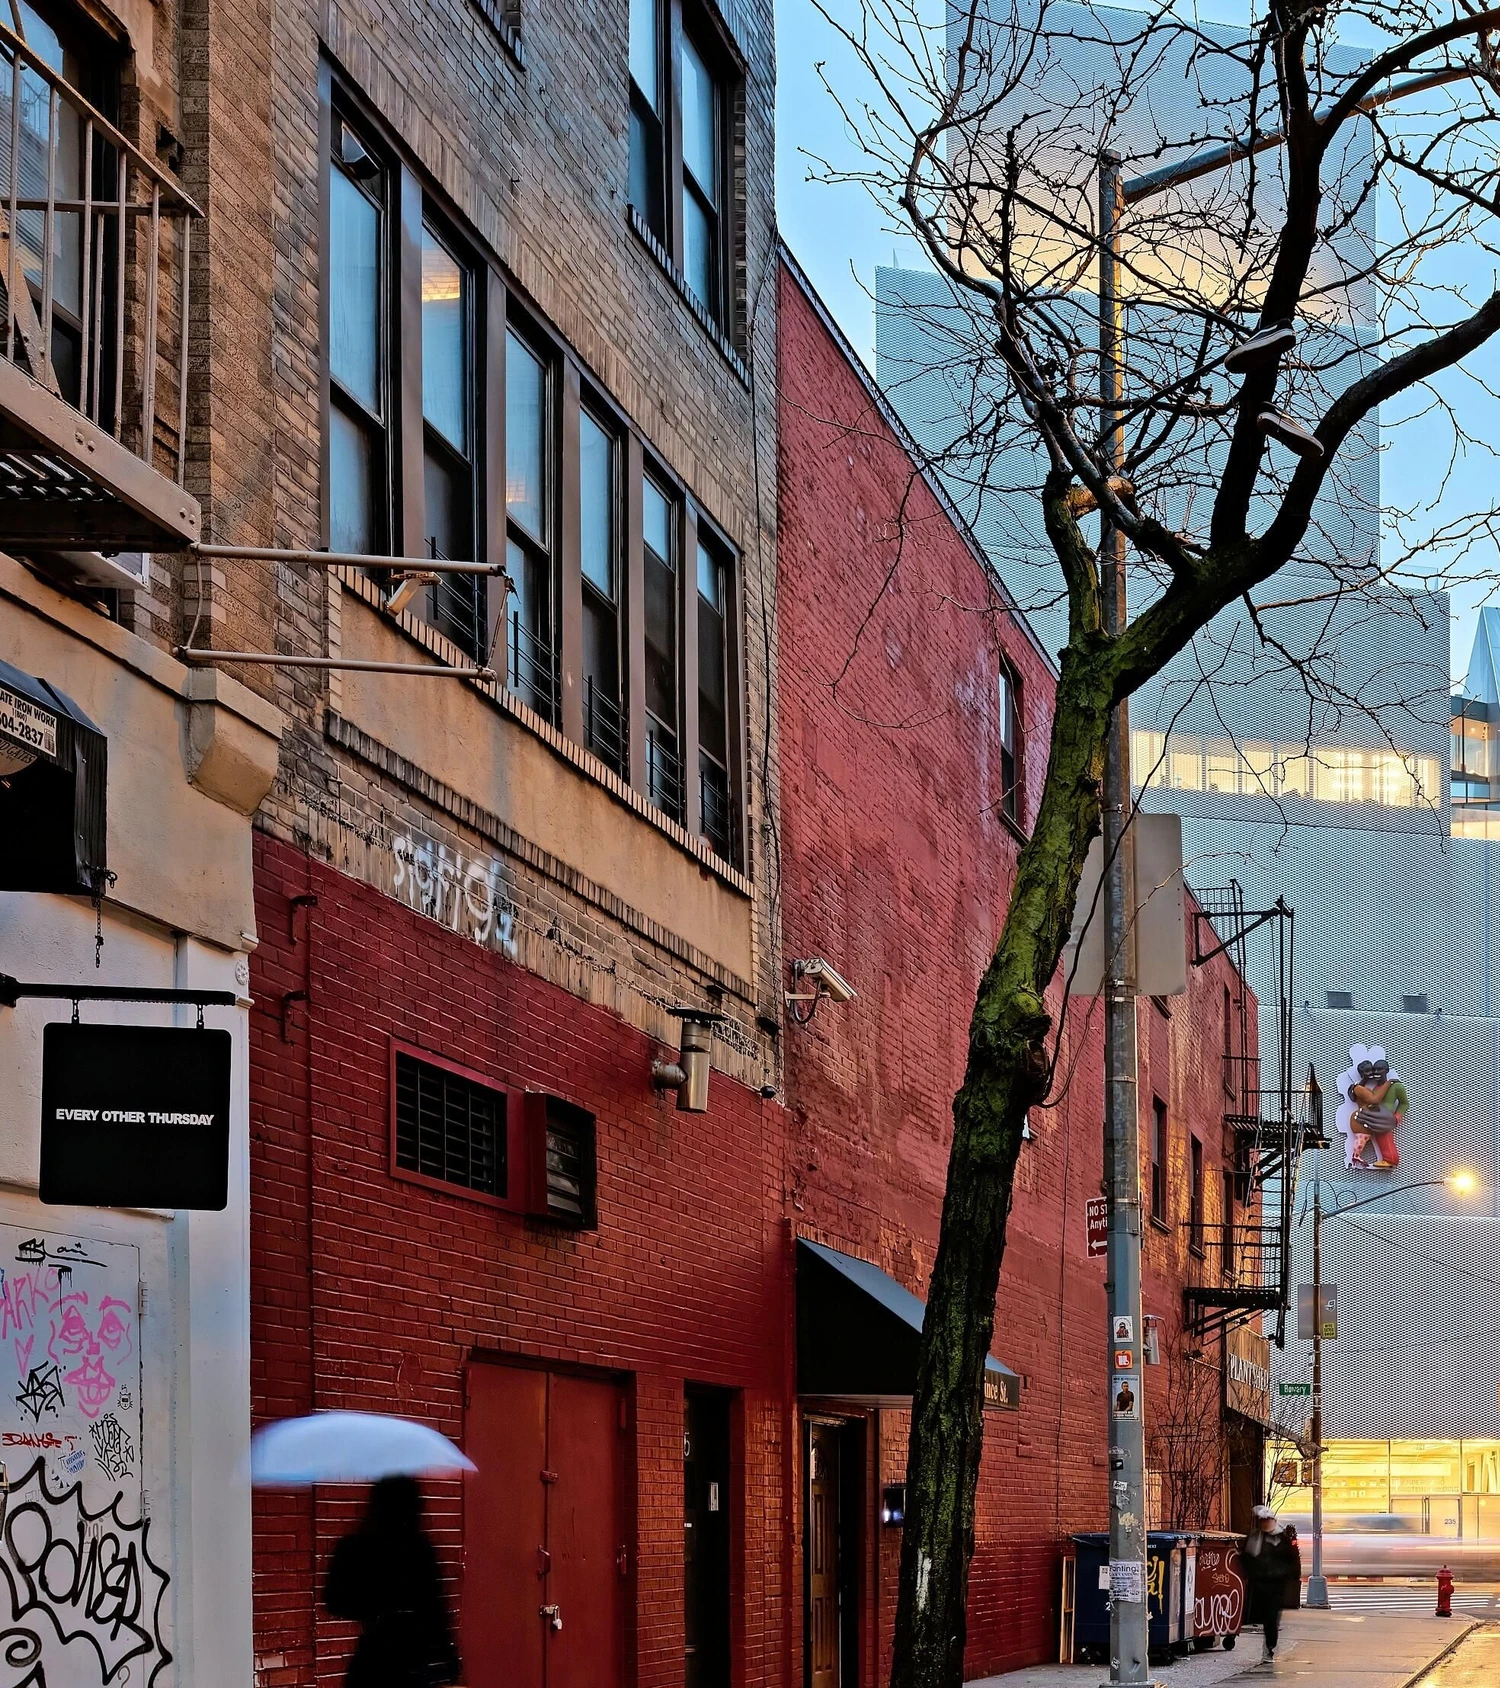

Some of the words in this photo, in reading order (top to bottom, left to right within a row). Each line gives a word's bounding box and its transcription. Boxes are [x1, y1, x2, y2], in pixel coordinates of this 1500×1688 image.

[14, 697, 32, 716] IRON
[33, 707, 56, 729] WORK
[0, 712, 44, 746] 04-2837
[6, 745, 36, 764] GATES
[55, 1108, 100, 1121] EVERY
[101, 1111, 146, 1123] OTHER
[147, 1112, 215, 1126] THURSDAY
[1089, 1205, 1099, 1217] NO
[999, 1380, 1009, 1404] St.
[1283, 1384, 1307, 1395] Bowery
